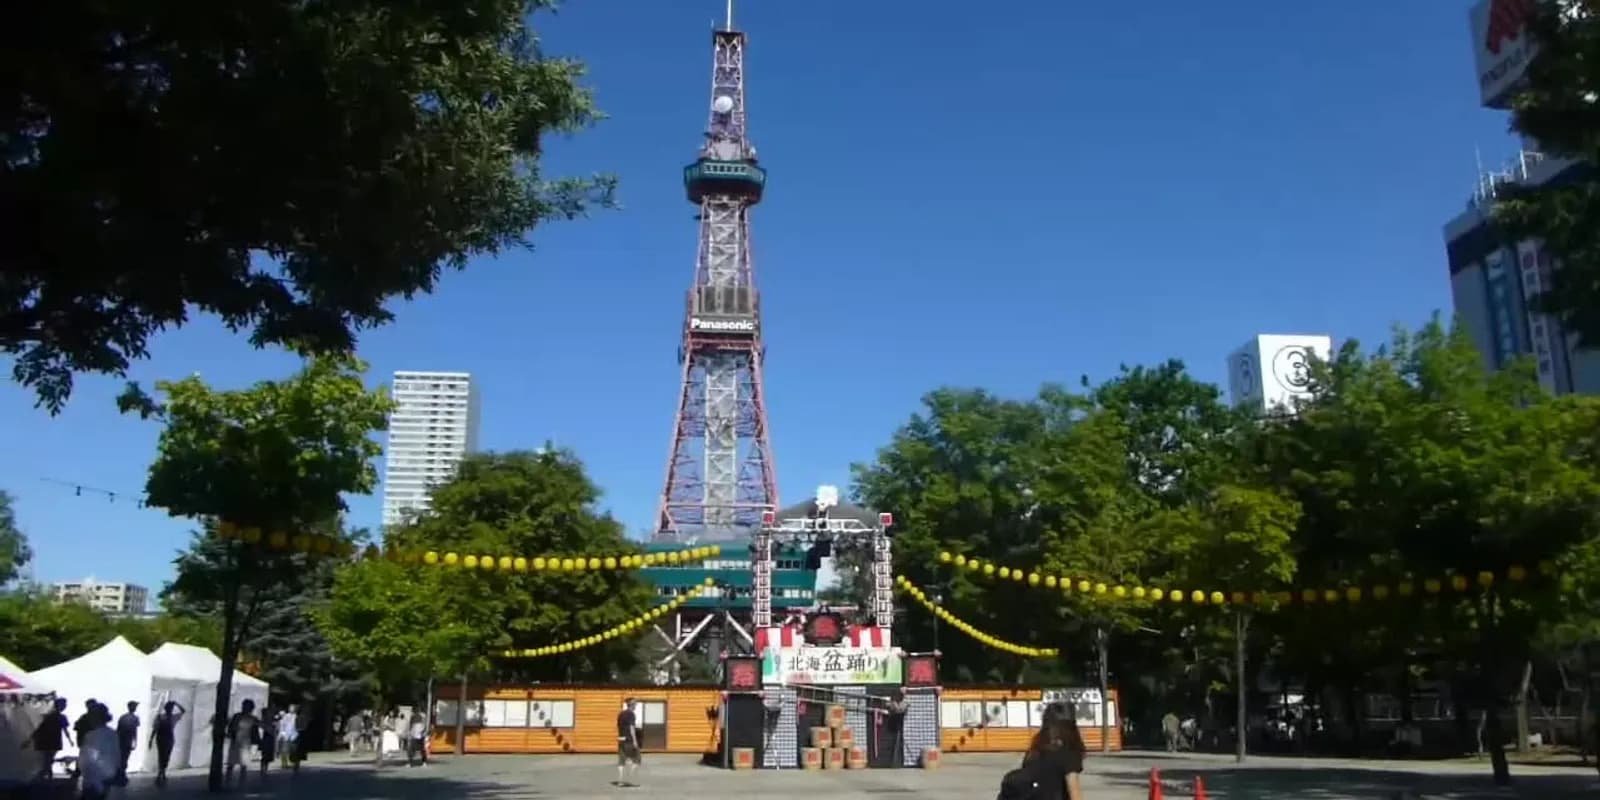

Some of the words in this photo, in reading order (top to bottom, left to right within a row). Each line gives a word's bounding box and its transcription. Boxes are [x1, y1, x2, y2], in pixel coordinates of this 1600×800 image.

[690, 318, 753, 330] Panasonic
[788, 649, 880, 672] 北海盆踊り
